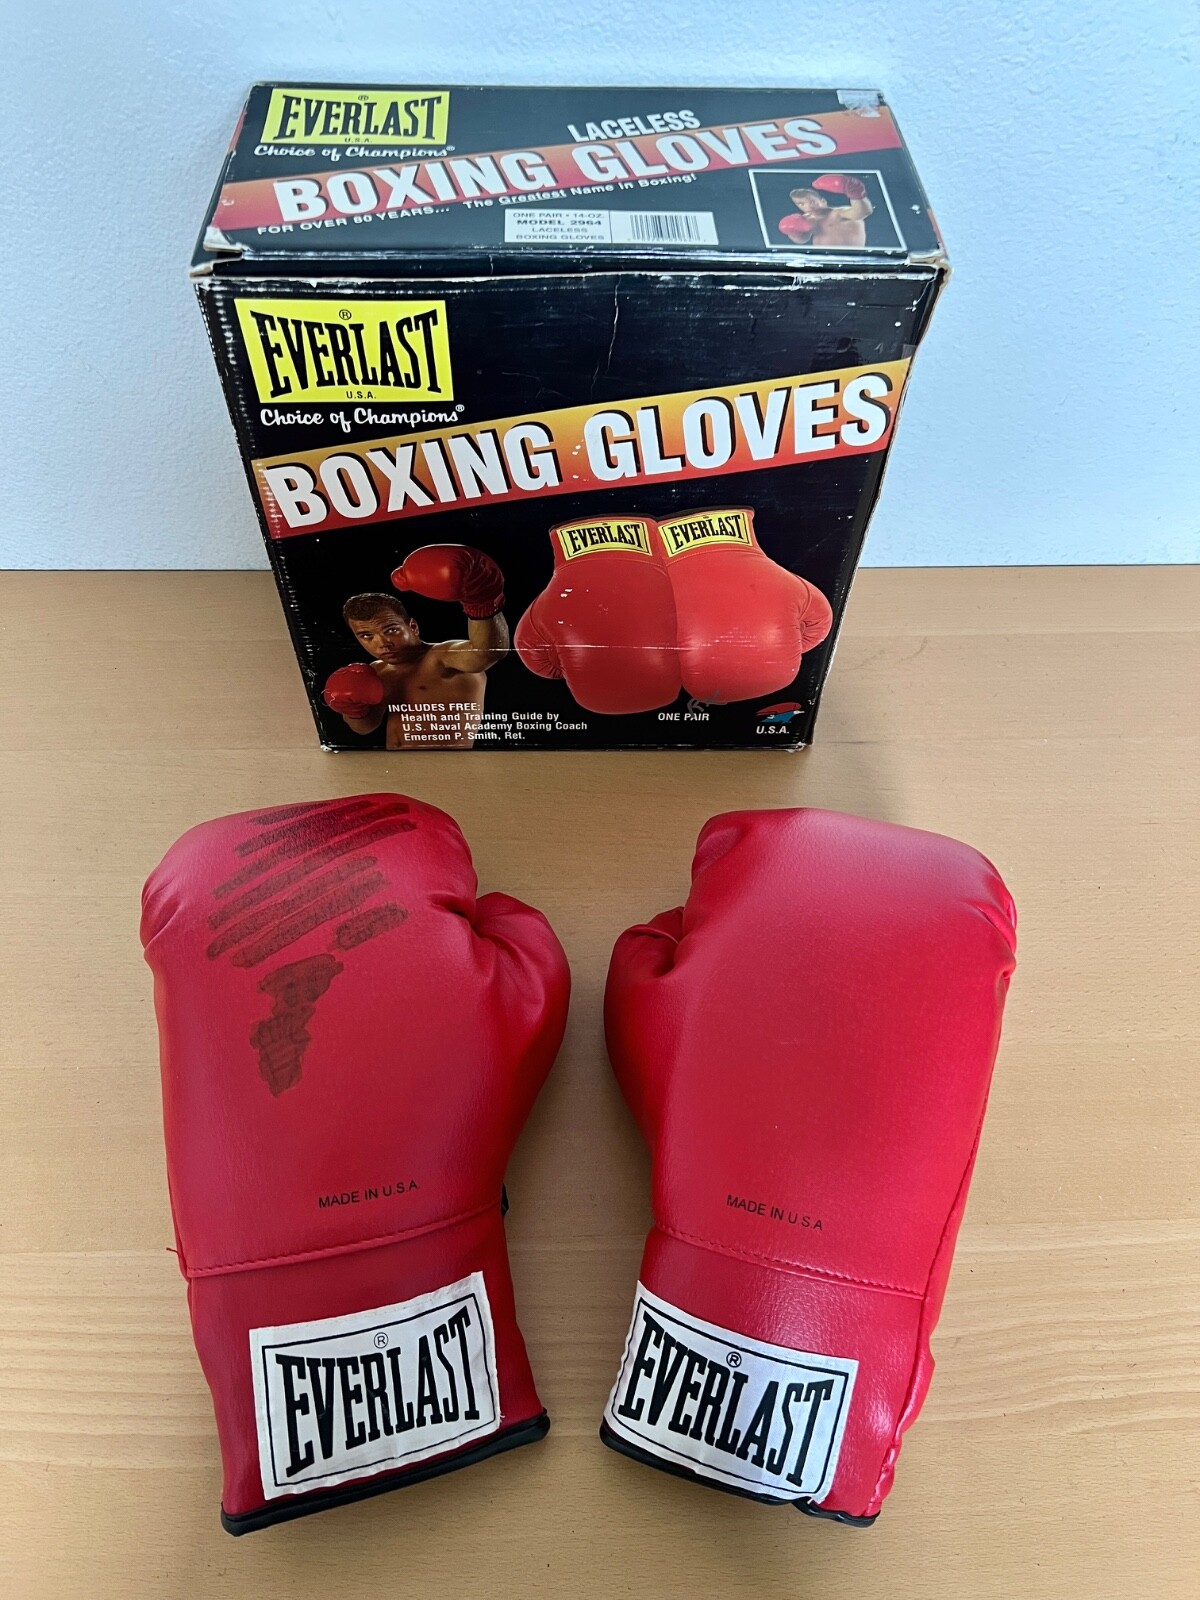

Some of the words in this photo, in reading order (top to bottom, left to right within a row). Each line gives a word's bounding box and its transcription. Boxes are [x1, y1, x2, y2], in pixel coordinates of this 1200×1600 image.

[273, 95, 442, 140] EVERLAST
[567, 110, 700, 143] LACELESS
[254, 145, 316, 157] Choice
[322, 146, 342, 161] of
[273, 151, 557, 222] BOXING
[571, 118, 836, 182] GLOVES
[257, 224, 294, 235] FOR
[300, 217, 348, 231] OVER
[463, 199, 493, 209] The
[498, 189, 567, 206] Greatest
[571, 182, 614, 195] Name
[640, 173, 698, 188] Boxing!
[250, 308, 442, 398] EVERLAST
[346, 390, 377, 400] U.S.A.
[260, 408, 324, 426] Choice
[330, 412, 352, 433] of
[263, 421, 563, 529] BOXING
[583, 372, 893, 482] GLOVES
[566, 523, 644, 554] EVERLAST
[668, 514, 744, 550] EVERLAST
[388, 703, 445, 713] INCLUDES
[449, 702, 481, 711] FREE:
[401, 713, 437, 722] Health
[440, 712, 460, 721] and
[464, 712, 508, 723] Training
[512, 712, 543, 721] Guide
[547, 712, 560, 723] by
[657, 712, 680, 721] ONE
[684, 712, 710, 721] PAIR
[403, 723, 426, 732] U.S.
[430, 722, 461, 731] Naval
[465, 721, 513, 733] Academy
[516, 721, 552, 732] Boxing
[555, 721, 588, 730] Coach
[404, 732, 450, 741] Emerson
[454, 732, 464, 740] P.
[467, 731, 502, 741] Smith,
[505, 731, 525, 740] Ret.
[756, 725, 790, 734] U.S.A.
[318, 1190, 361, 1208] MADE
[364, 1188, 379, 1200] IN
[726, 1194, 767, 1216] MADE
[770, 1206, 785, 1221] IN
[275, 1305, 480, 1478] EVERLAST
[618, 1310, 835, 1488] EVERLAST
